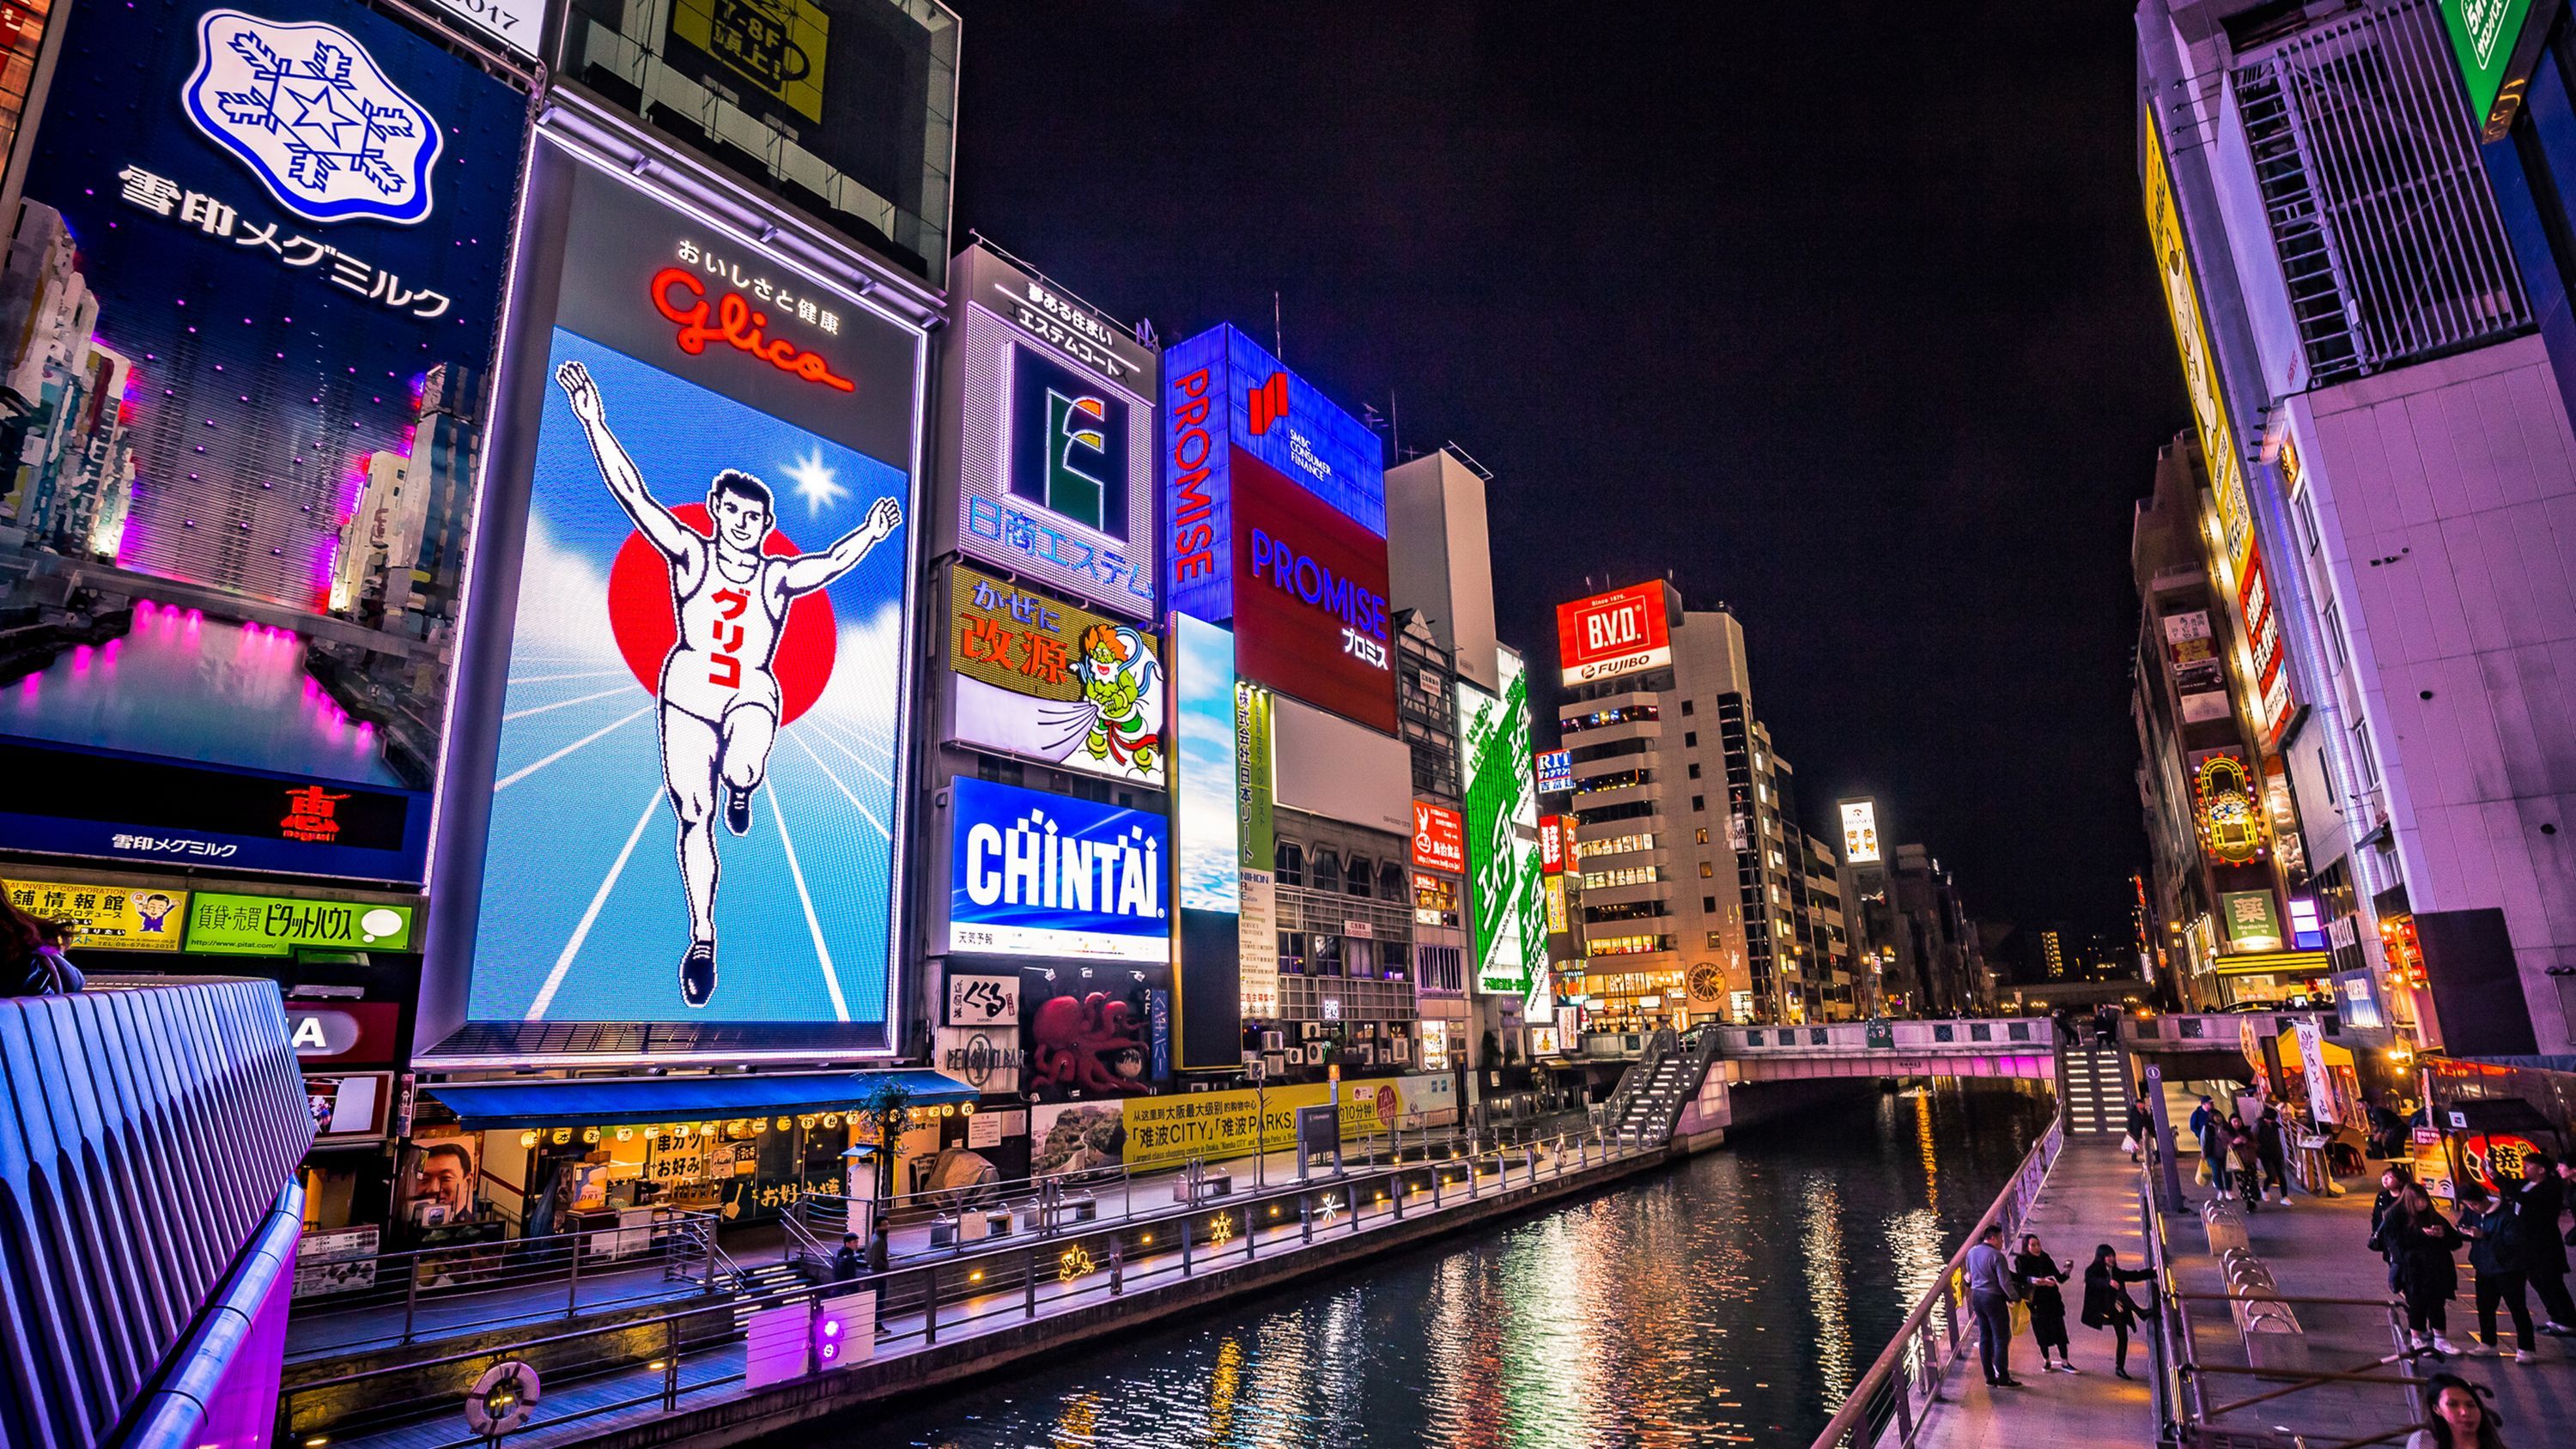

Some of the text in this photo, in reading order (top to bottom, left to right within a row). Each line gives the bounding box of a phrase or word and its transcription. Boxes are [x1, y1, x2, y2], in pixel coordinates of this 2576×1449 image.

[117, 163, 452, 318] 雪印メグミルク
[677, 239, 841, 336] おいしさと健康
[1028, 282, 1114, 347] 夢ある住まい
[1018, 307, 1120, 379] エステムコート
[1290, 428, 1311, 451] SMBC
[1290, 440, 1332, 476] CONSUMER
[1175, 368, 1213, 583] PROMISE
[1291, 451, 1325, 482] FINANCE
[970, 494, 1154, 600] 日商エステム
[972, 579, 1061, 634] かぜに
[1252, 528, 1387, 641] PROMISE
[708, 587, 751, 689] グリコ
[961, 612, 1069, 684] 改源
[1341, 627, 1388, 671] プロミス
[1588, 606, 1643, 651] B.V.D.
[1597, 655, 1650, 675] FUJIBO
[1508, 697, 1533, 768] エイブル
[280, 785, 351, 834] 恵
[112, 833, 238, 858] 雪印メグミルク
[967, 808, 1158, 919] CHINTAI
[1477, 799, 1517, 932] エイブル
[60, 885, 127, 896] CORPORATION
[2233, 897, 2267, 923] 薬
[191, 939, 277, 949] http://www.pitat.com/
[197, 903, 353, 941] 賃貸・売買 ピタットハウス
[963, 981, 1006, 1018] くくる
[657, 1155, 701, 1178] お好み
